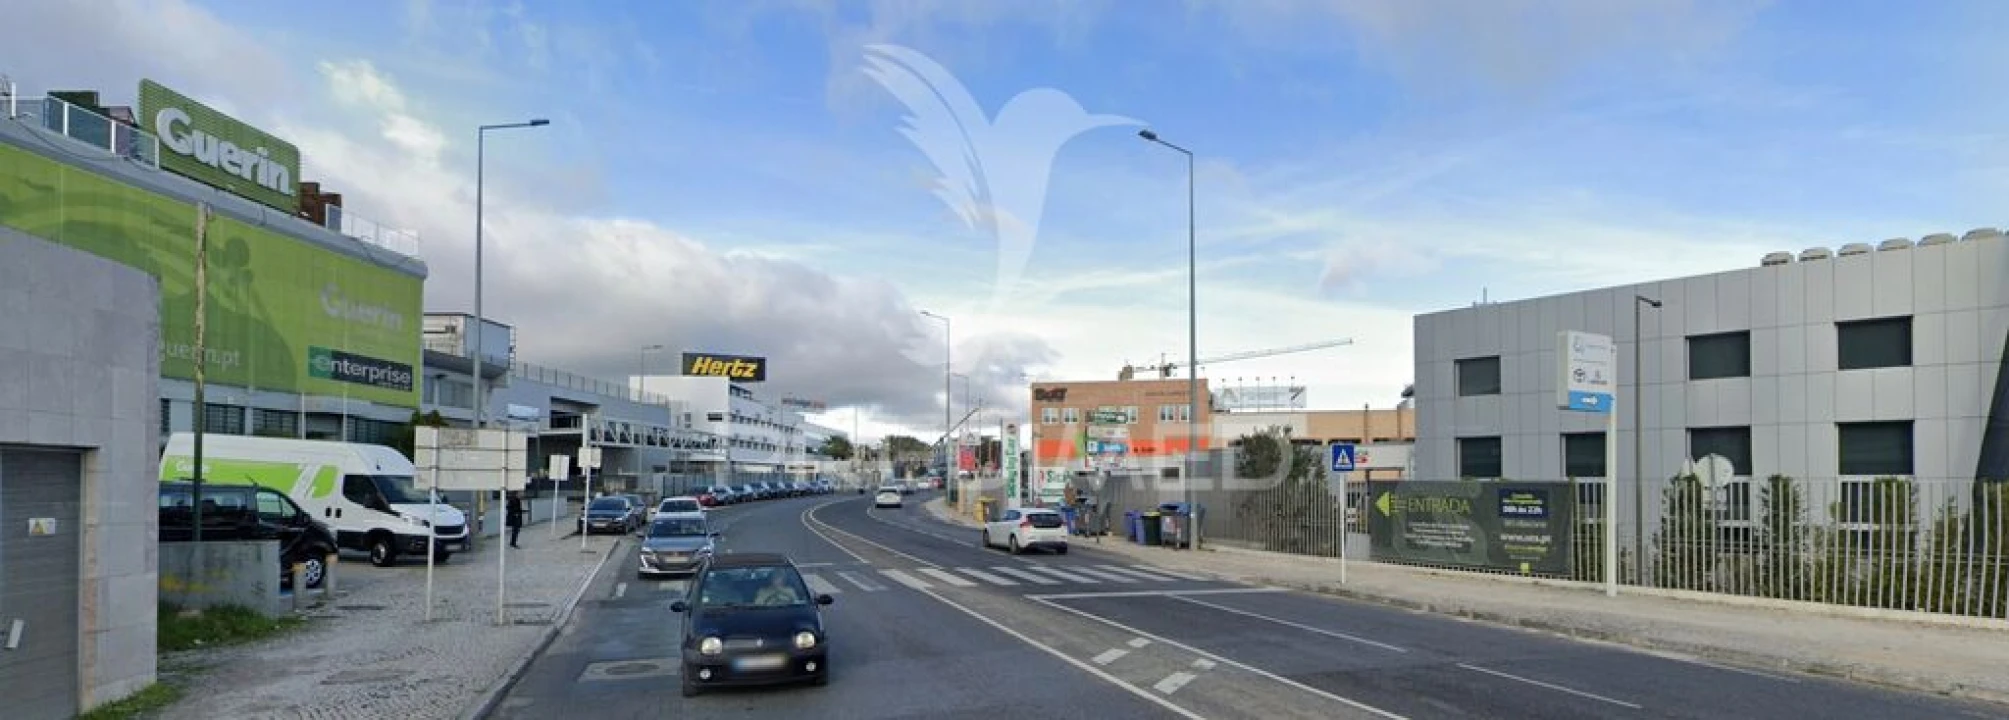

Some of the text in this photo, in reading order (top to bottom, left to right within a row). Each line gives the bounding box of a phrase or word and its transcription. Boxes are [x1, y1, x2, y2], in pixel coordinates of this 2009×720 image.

[157, 107, 290, 196] Guerin
[321, 281, 403, 331] Guerin
[312, 354, 410, 383] enterprise
[691, 356, 758, 378] Hertz
[1408, 497, 1471, 514] ENTRADA
